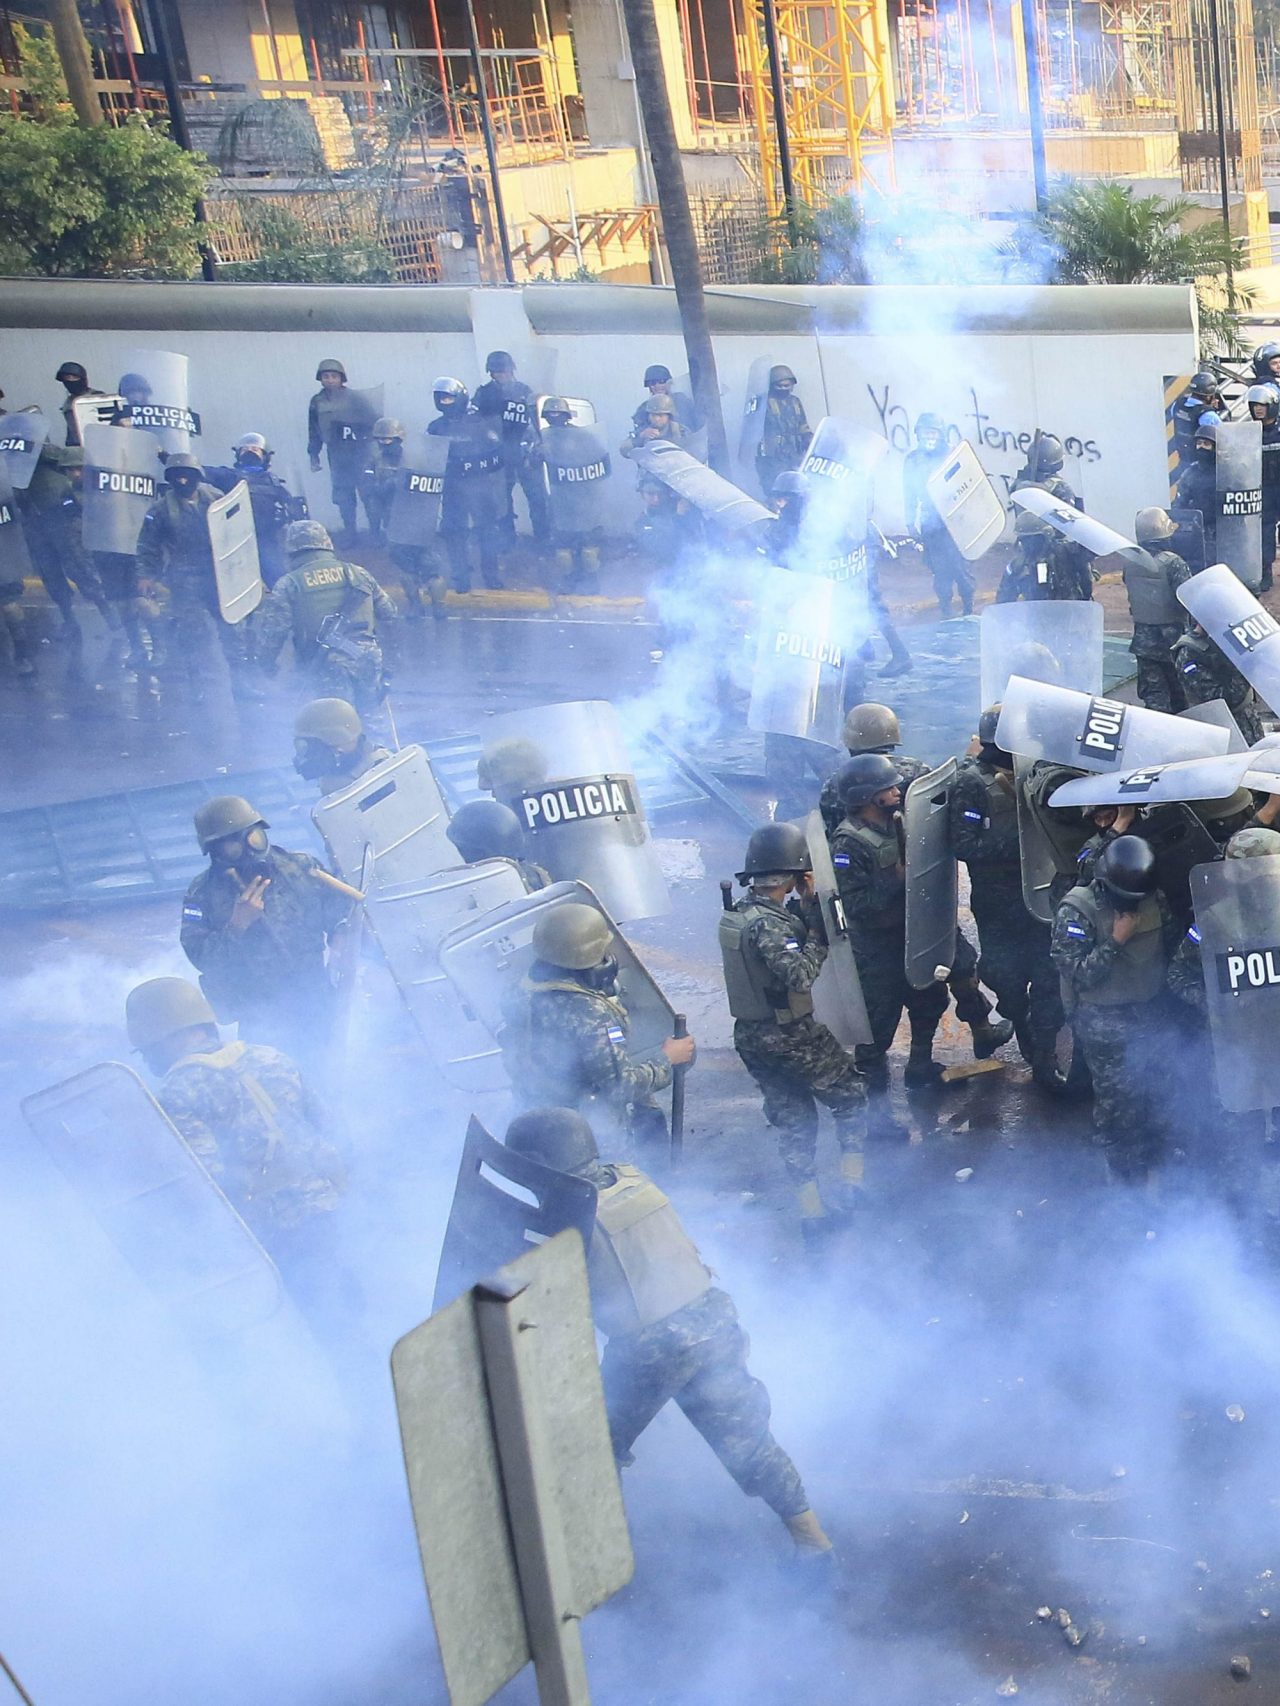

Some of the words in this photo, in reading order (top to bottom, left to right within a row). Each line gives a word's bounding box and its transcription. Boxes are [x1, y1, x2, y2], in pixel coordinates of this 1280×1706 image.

[130, 416, 197, 433] MILITAR
[132, 406, 194, 423] POLICIA
[557, 462, 606, 482] POLICIA
[99, 472, 153, 496] POLICIA
[775, 631, 842, 668] POLICIA
[522, 783, 628, 829] POLICIA
